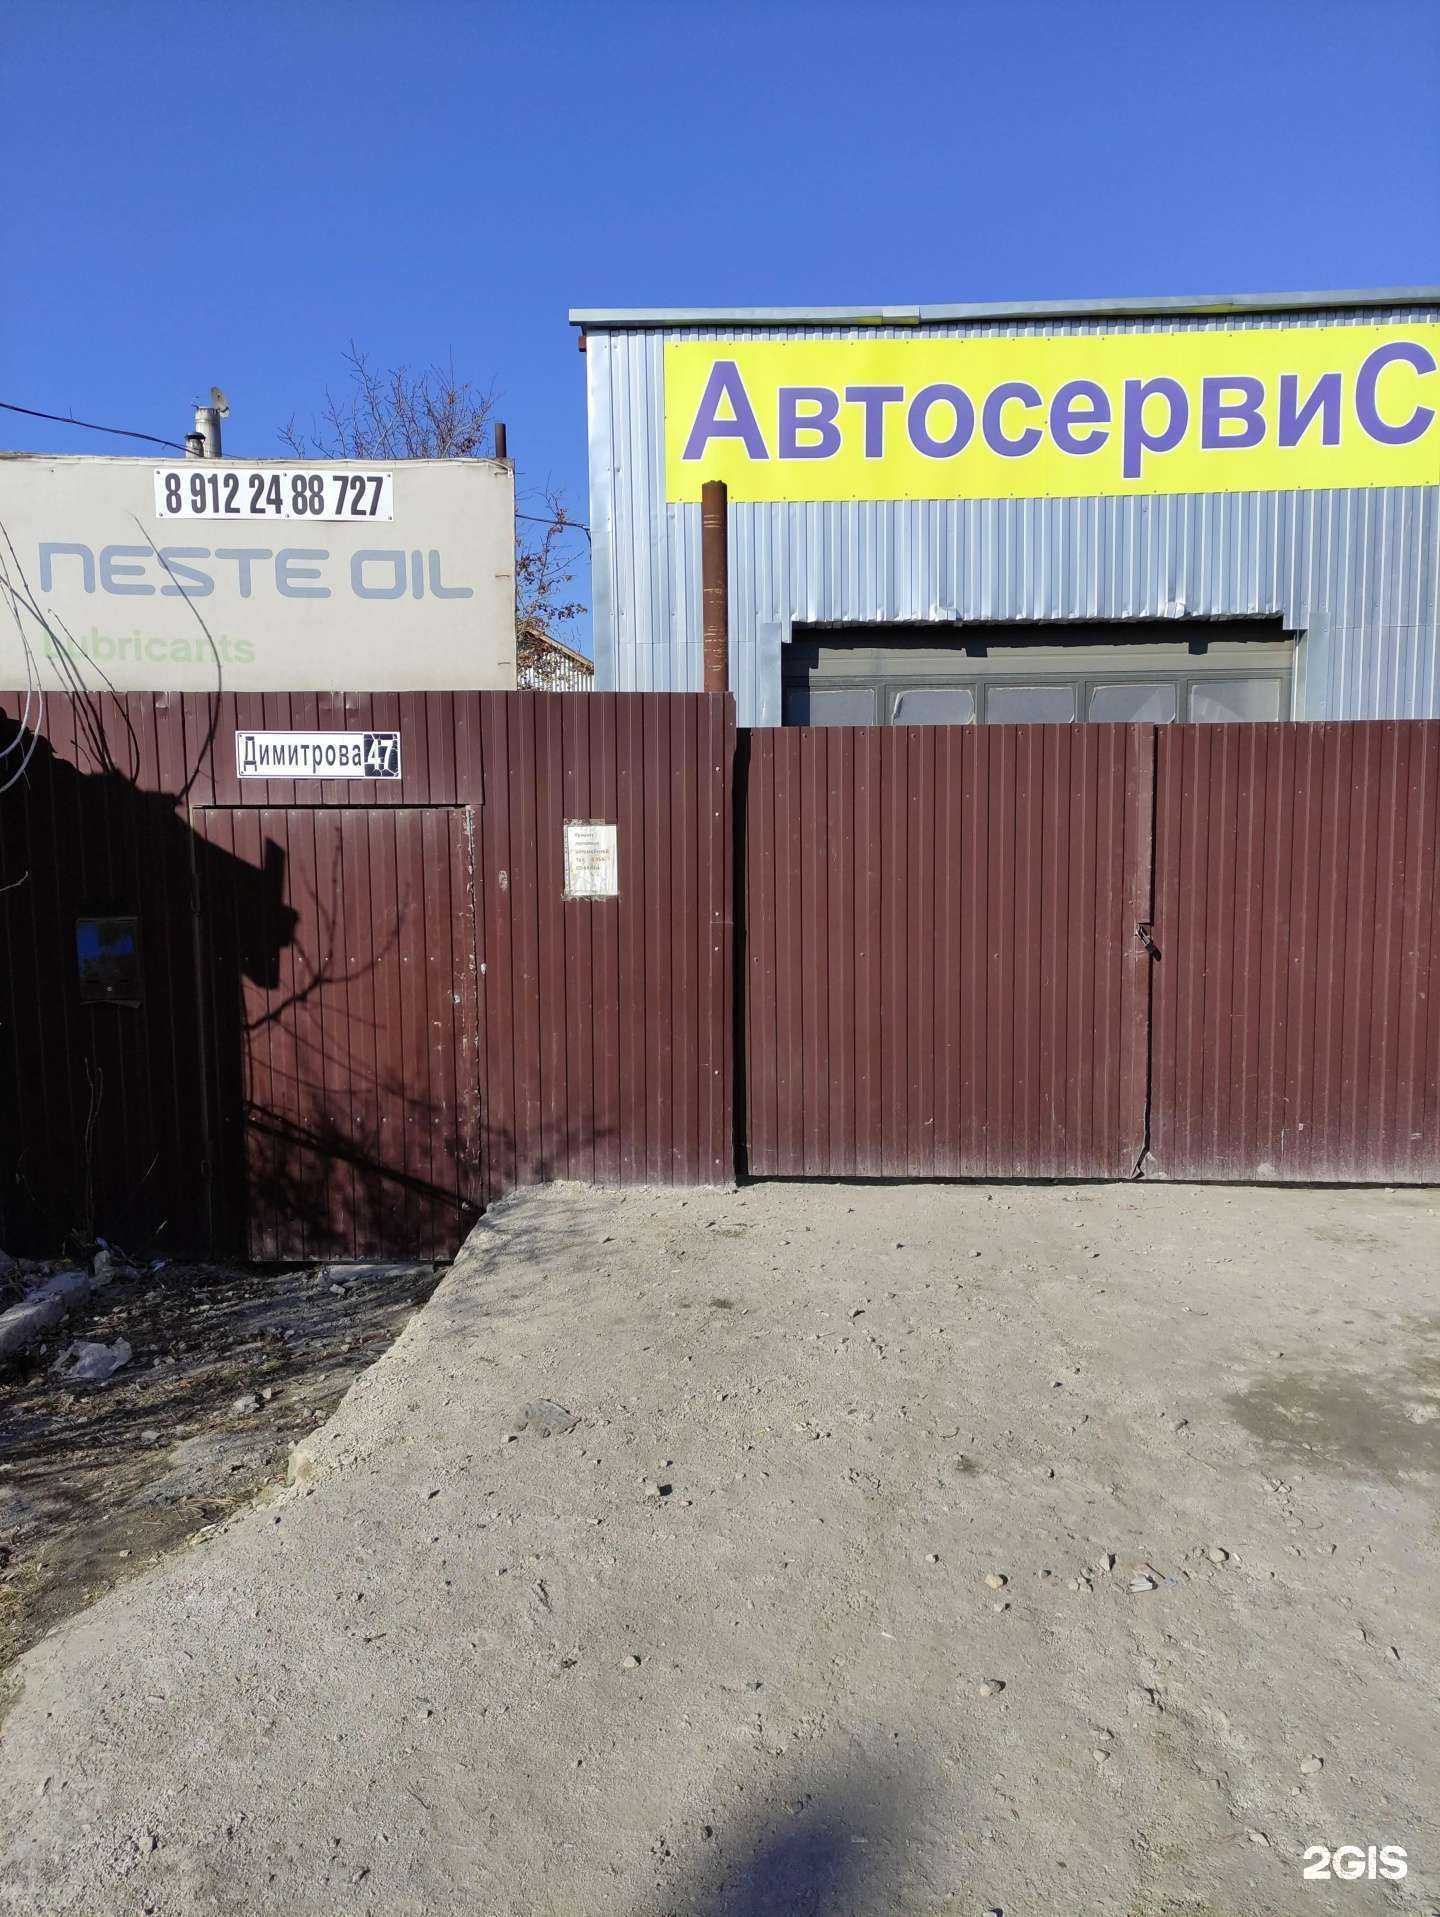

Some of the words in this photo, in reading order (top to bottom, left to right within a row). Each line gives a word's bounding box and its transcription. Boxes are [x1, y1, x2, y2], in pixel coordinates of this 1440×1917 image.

[164, 472, 182, 514] 8
[190, 472, 241, 514] 912
[248, 473, 283, 514] 24
[291, 474, 325, 515] 88
[332, 475, 384, 516] 727
[350, 548, 474, 600] OIL
[243, 736, 362, 774] Димитрова
[366, 738, 394, 770] 47
